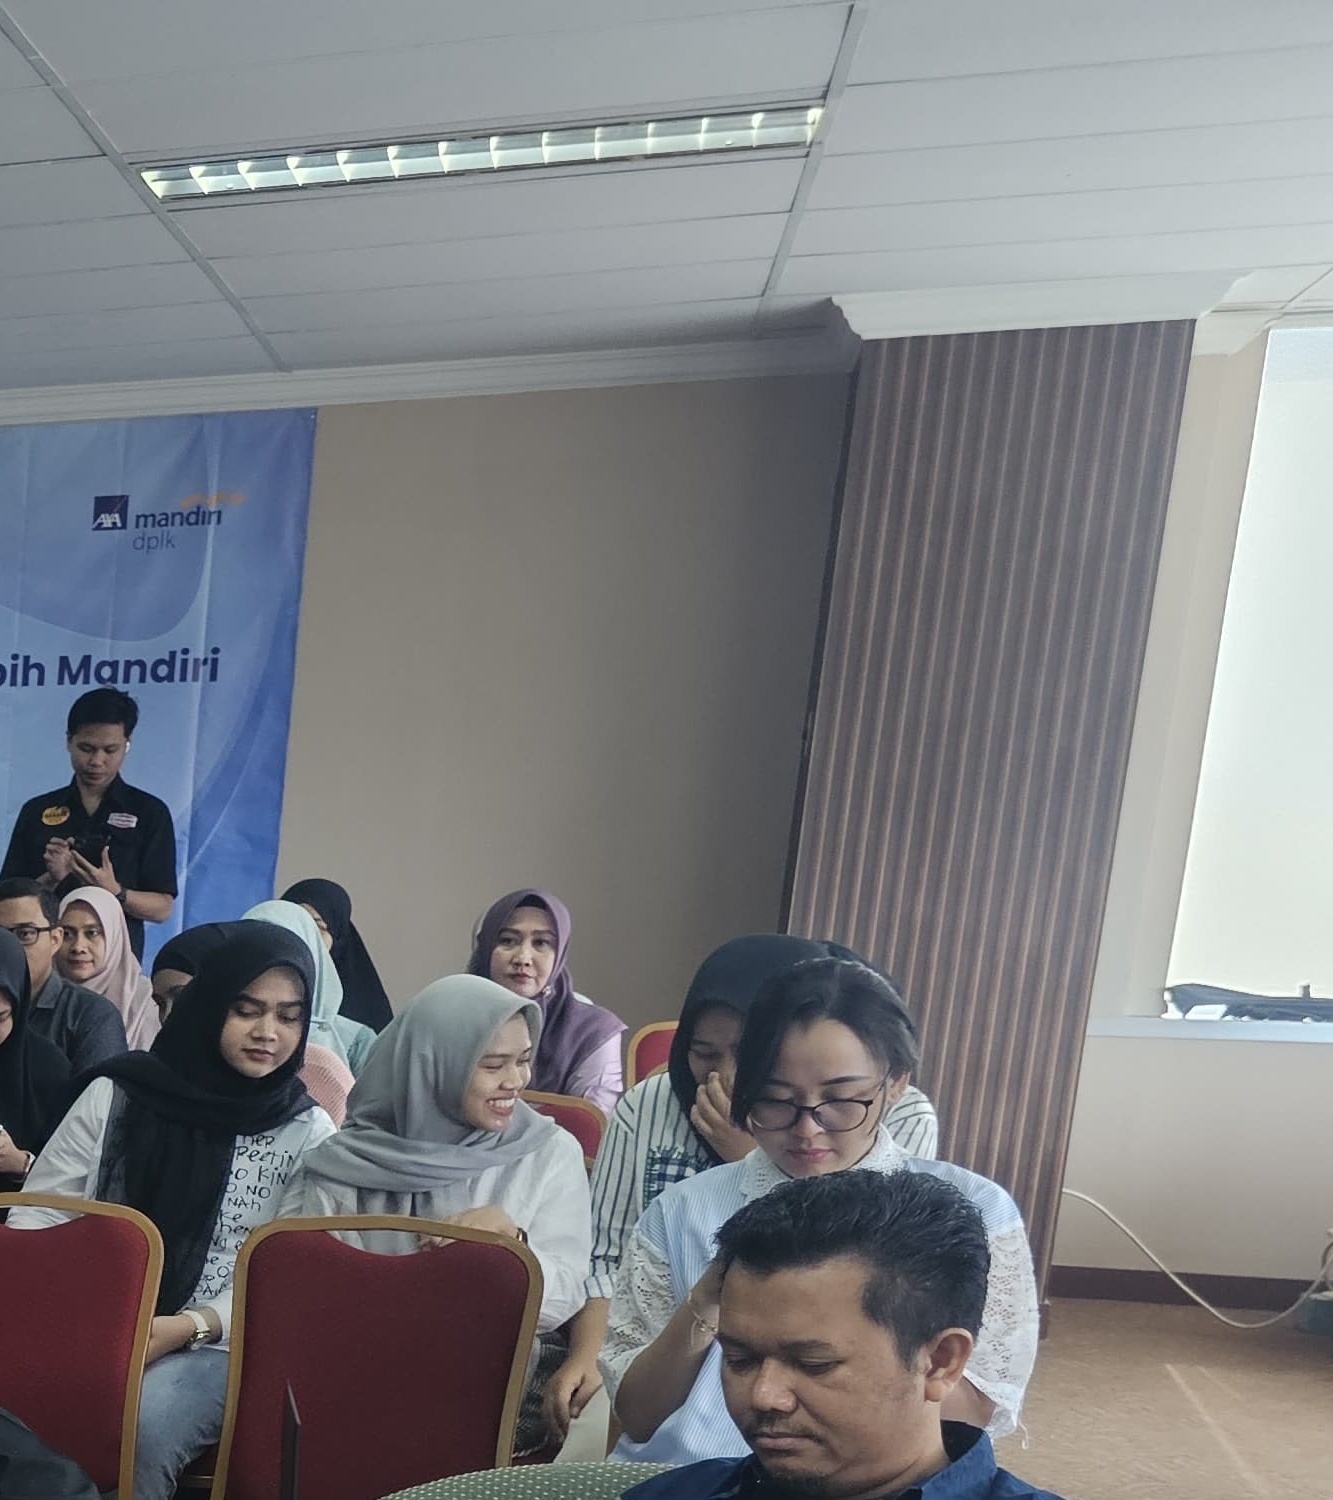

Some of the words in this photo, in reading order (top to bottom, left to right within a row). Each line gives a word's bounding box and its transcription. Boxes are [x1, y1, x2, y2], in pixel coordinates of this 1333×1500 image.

[93, 512, 122, 528] AXA
[135, 505, 222, 529] mandiri
[133, 530, 176, 555] dplk
[57, 647, 221, 686] Mandiri
